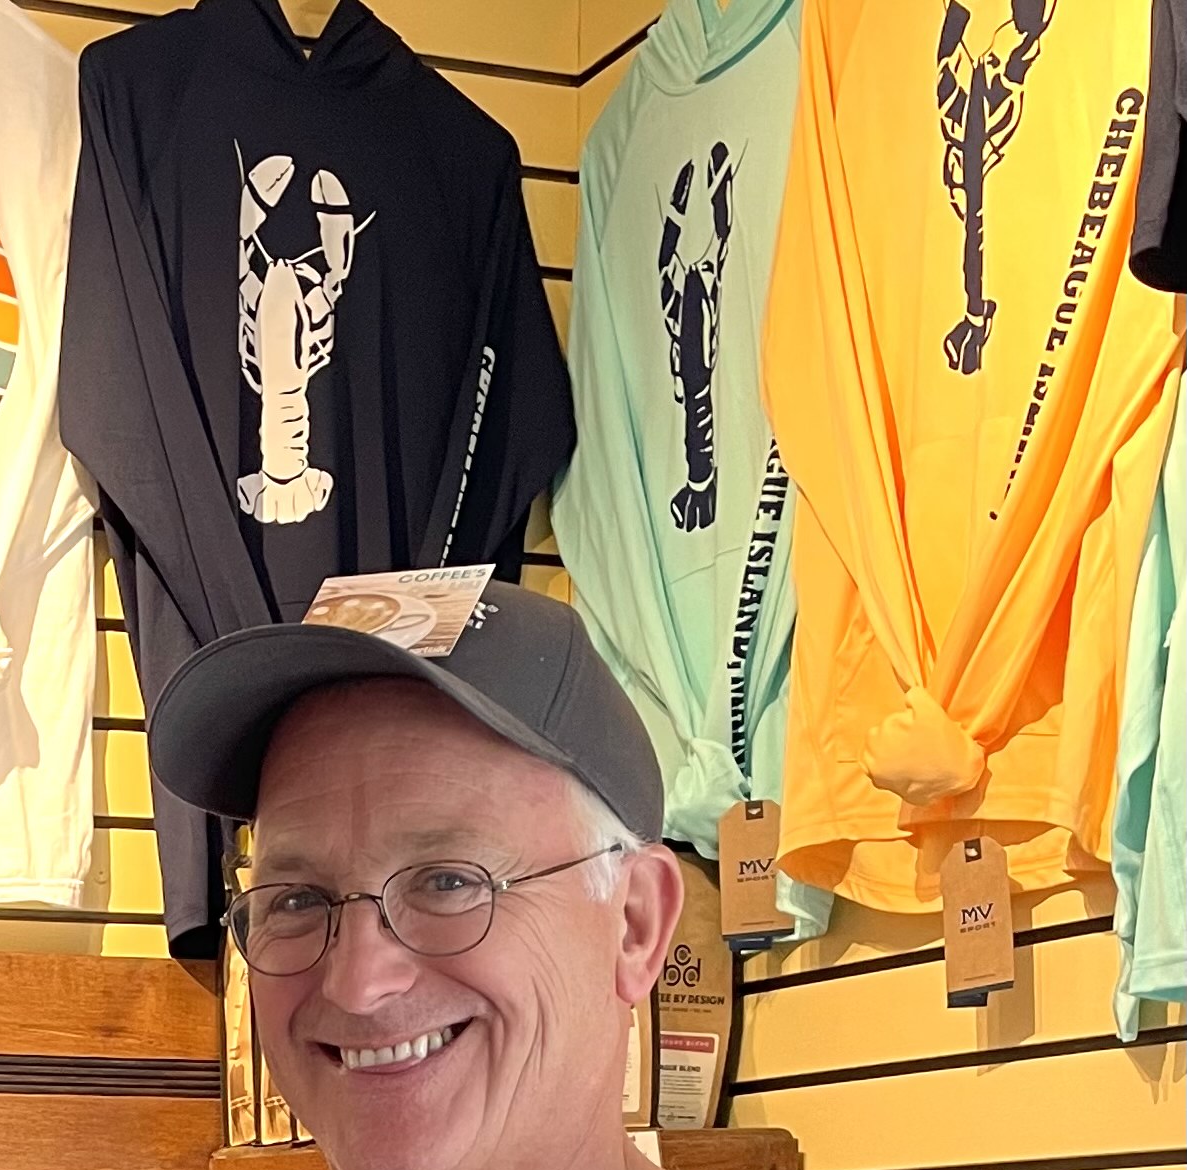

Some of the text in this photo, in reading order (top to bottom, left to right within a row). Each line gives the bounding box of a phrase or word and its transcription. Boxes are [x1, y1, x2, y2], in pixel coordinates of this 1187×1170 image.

[1045, 86, 1145, 352] CHEBEAGUE
[397, 568, 487, 584] COFFEE'S
[739, 857, 774, 875] MV
[961, 902, 994, 925] MV
[673, 993, 687, 1004] BY
[687, 993, 725, 1006] DESIGN
